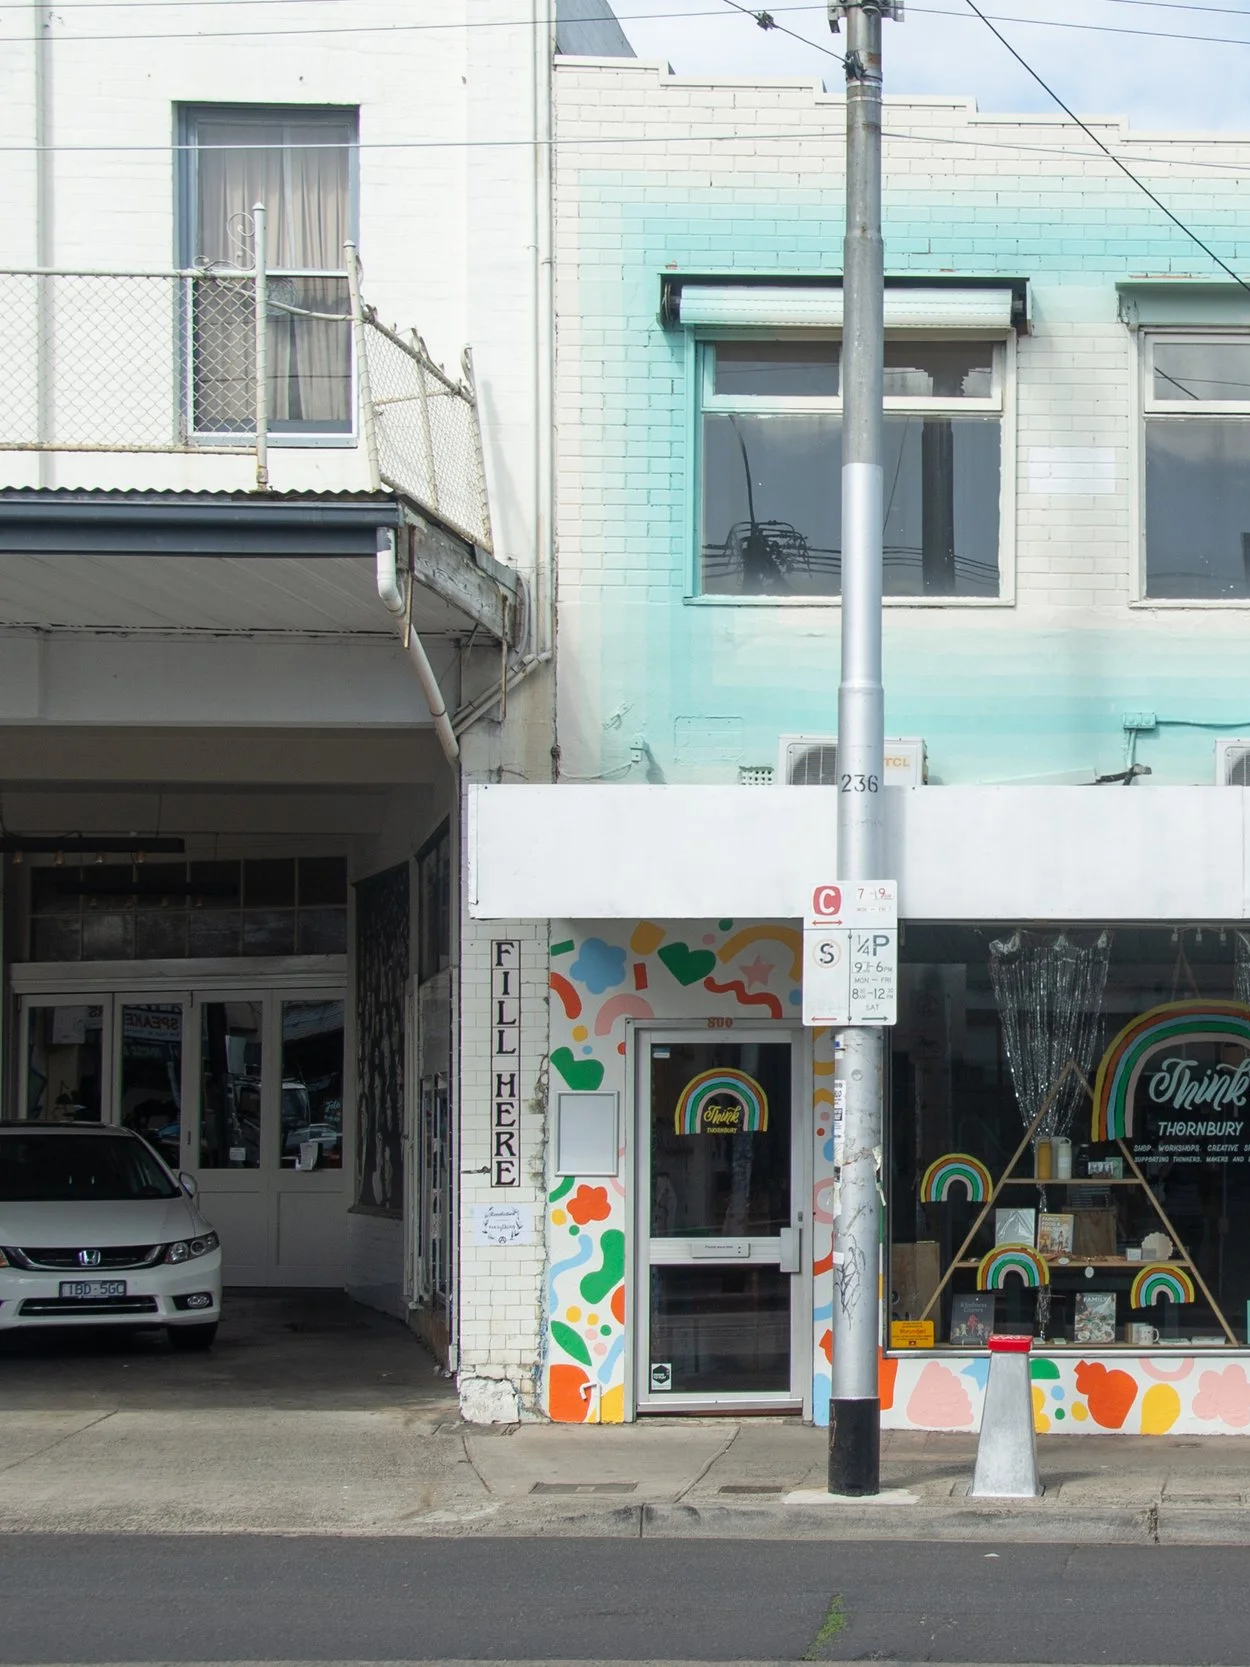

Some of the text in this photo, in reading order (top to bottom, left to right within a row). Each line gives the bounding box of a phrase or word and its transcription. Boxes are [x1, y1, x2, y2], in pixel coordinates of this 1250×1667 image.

[884, 757, 910, 768] TCL
[841, 774, 879, 793] 236
[494, 942, 517, 1054] FILL
[703, 1104, 743, 1124] Think
[494, 1073, 517, 1187] HERE
[1157, 1121, 1245, 1136] THORNBURY
[1207, 1144, 1240, 1152] CREATIVE
